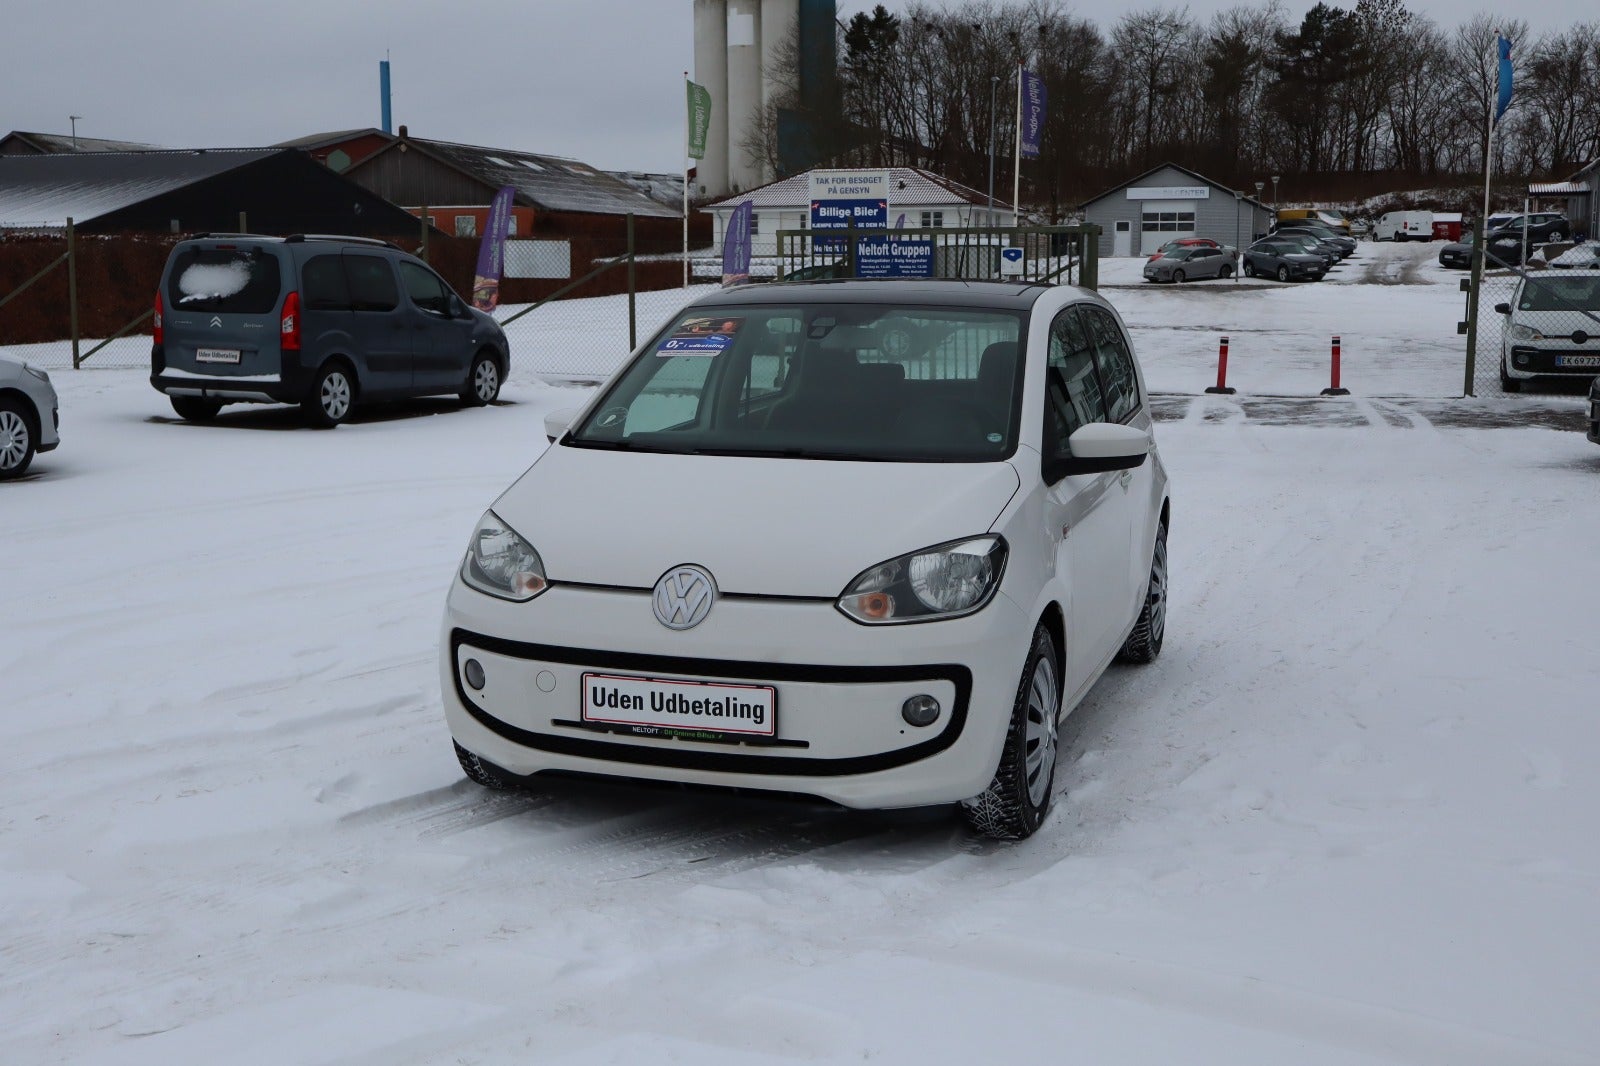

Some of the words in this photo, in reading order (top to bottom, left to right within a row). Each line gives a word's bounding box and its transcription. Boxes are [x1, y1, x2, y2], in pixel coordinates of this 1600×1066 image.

[815, 177, 830, 185] TAK
[832, 177, 847, 185] FOR
[849, 176, 883, 184] BESØGET
[828, 186, 838, 194] PÅ
[819, 207, 851, 218] Billige
[854, 206, 879, 216] Biler
[858, 243, 889, 256] Neltoft
[891, 243, 931, 258] Gruppen
[211, 351, 238, 360] Udbetaling
[592, 686, 644, 711] Uden
[650, 691, 765, 724] Udbetaling
[632, 726, 659, 735] NELTOFT
